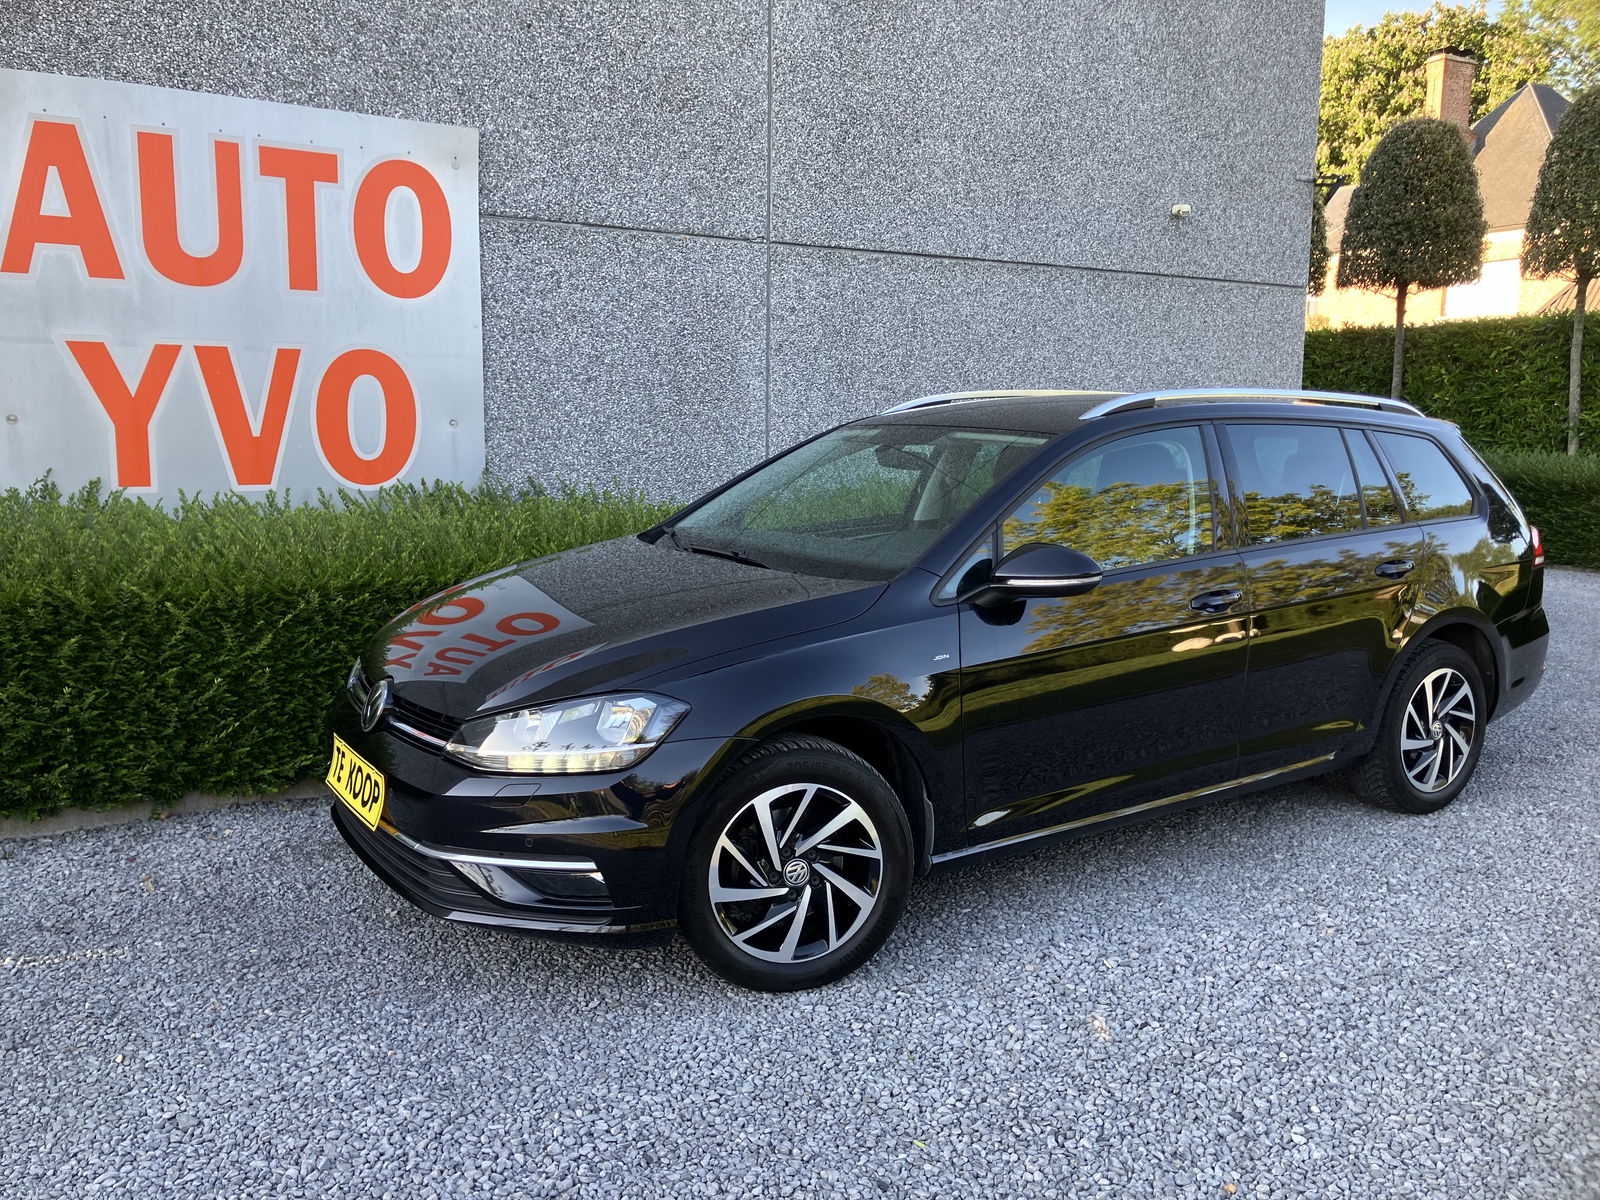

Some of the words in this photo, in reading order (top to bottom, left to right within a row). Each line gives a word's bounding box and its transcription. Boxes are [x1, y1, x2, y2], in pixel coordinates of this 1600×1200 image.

[0, 119, 452, 300] AUTO
[64, 339, 418, 488] YVO
[932, 653, 950, 661] JOIN
[332, 745, 346, 784] TE
[344, 757, 381, 813] KOOP
